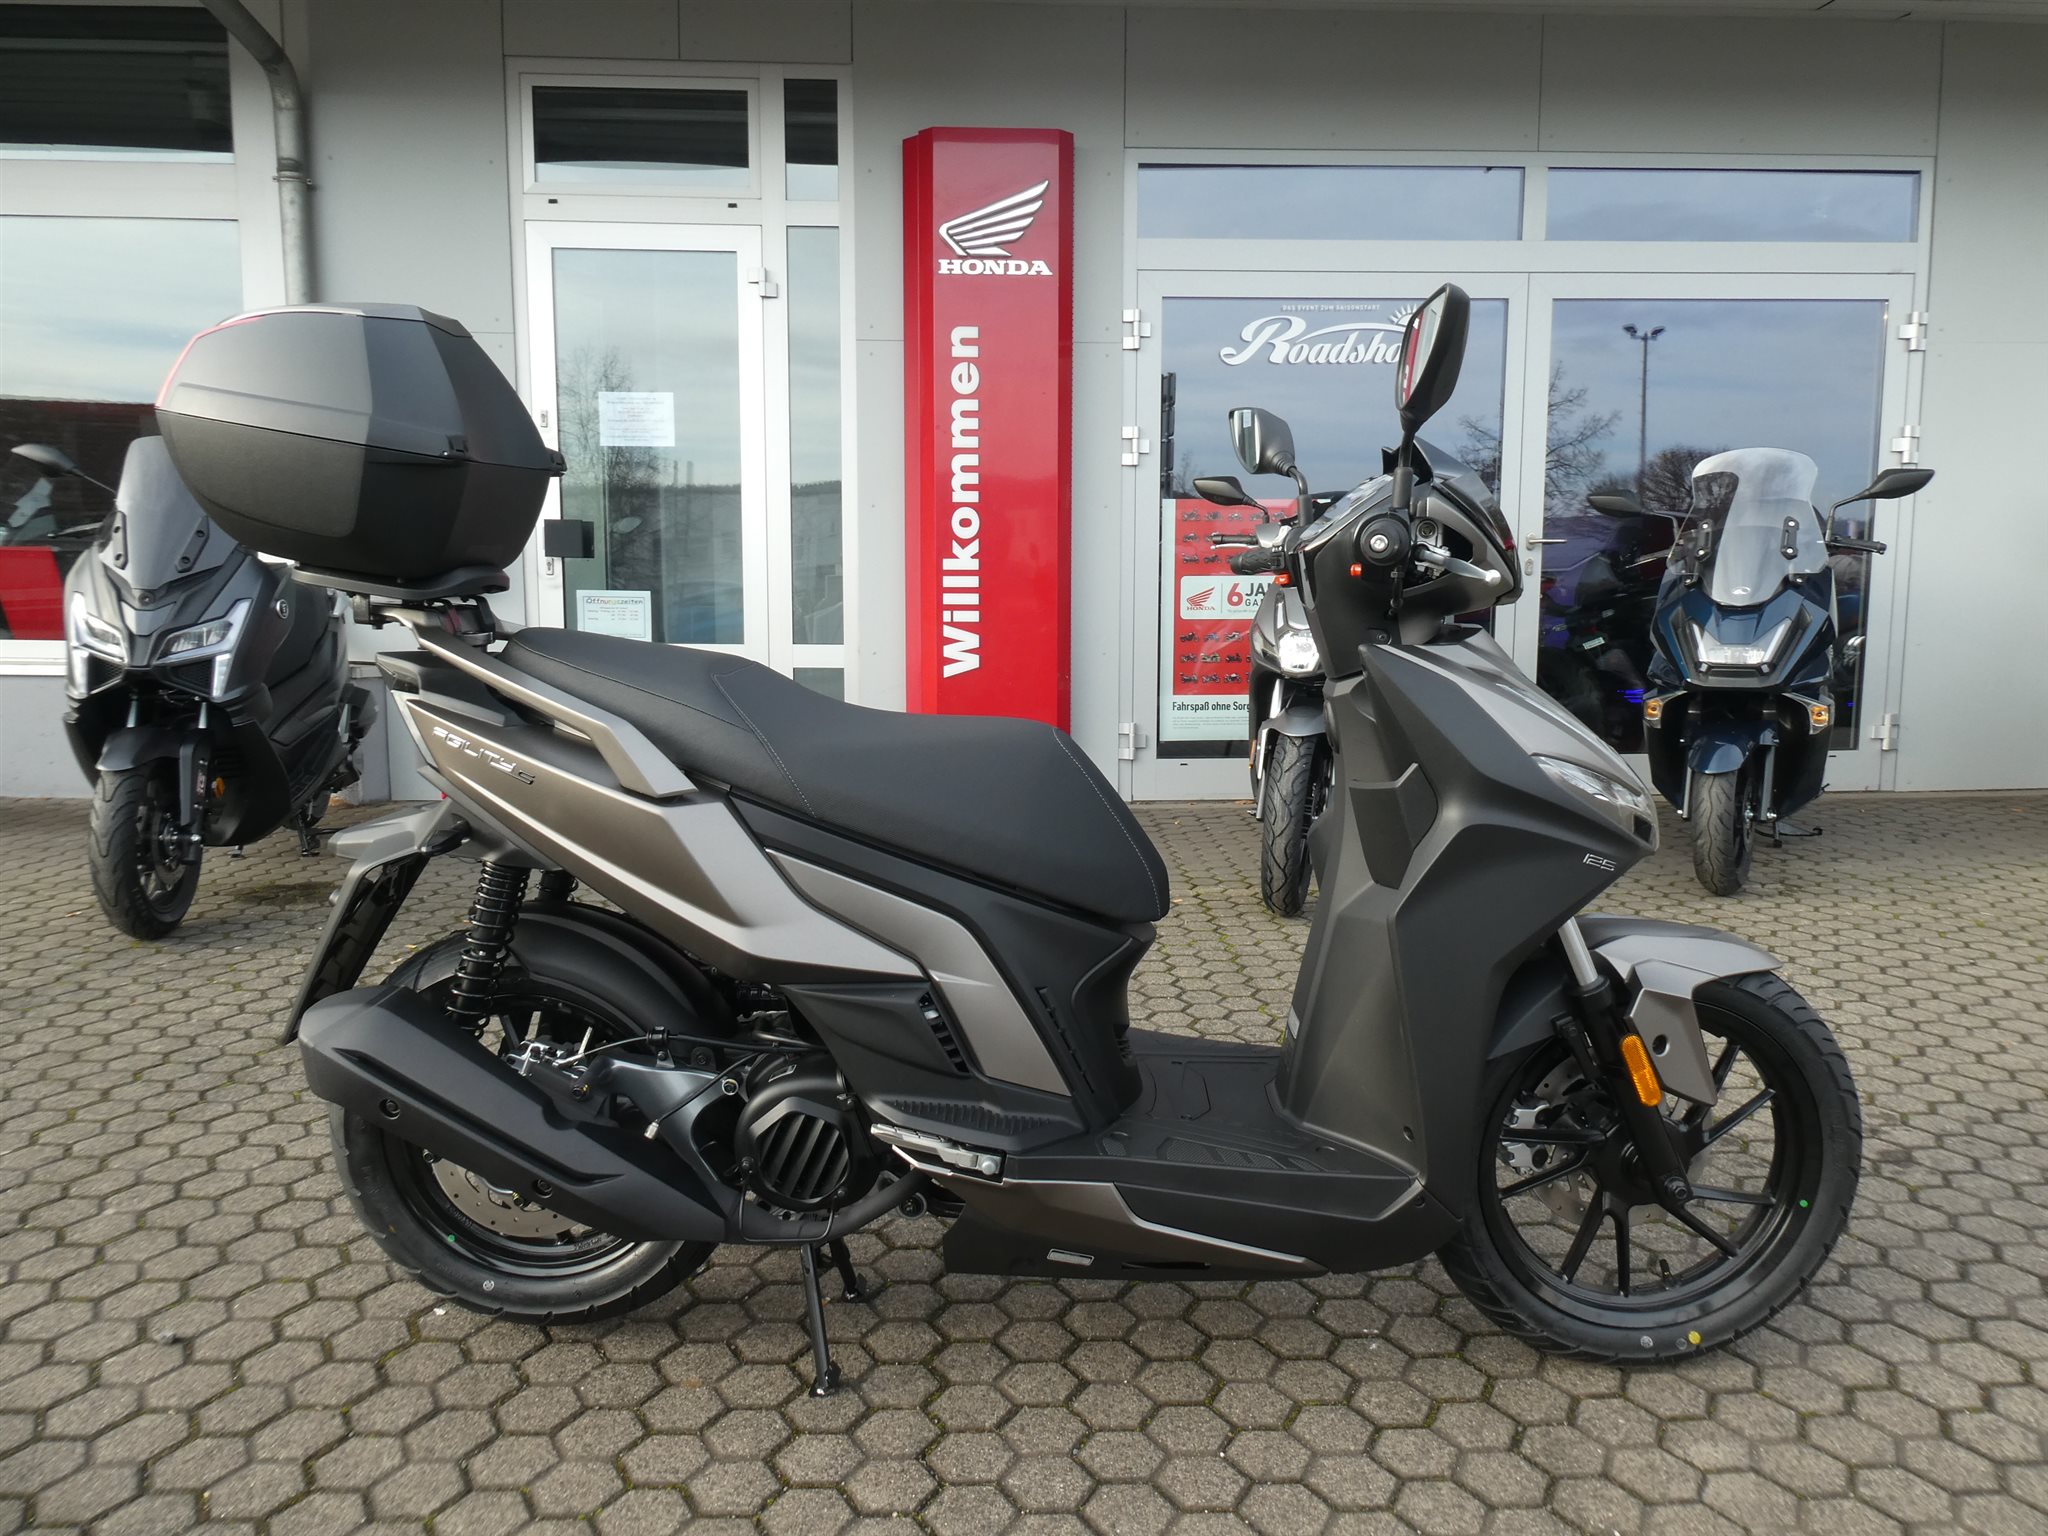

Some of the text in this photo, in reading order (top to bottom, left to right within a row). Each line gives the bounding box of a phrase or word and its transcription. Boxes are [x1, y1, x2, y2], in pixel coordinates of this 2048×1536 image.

[938, 259, 1053, 275] HONDA
[942, 325, 980, 678] Willkommen
[1227, 582, 1244, 607] 6
[1245, 598, 1264, 606] GA
[1172, 702, 1209, 712] Fahrspaß
[1211, 702, 1231, 711] ohne
[1583, 853, 1616, 871] 125
